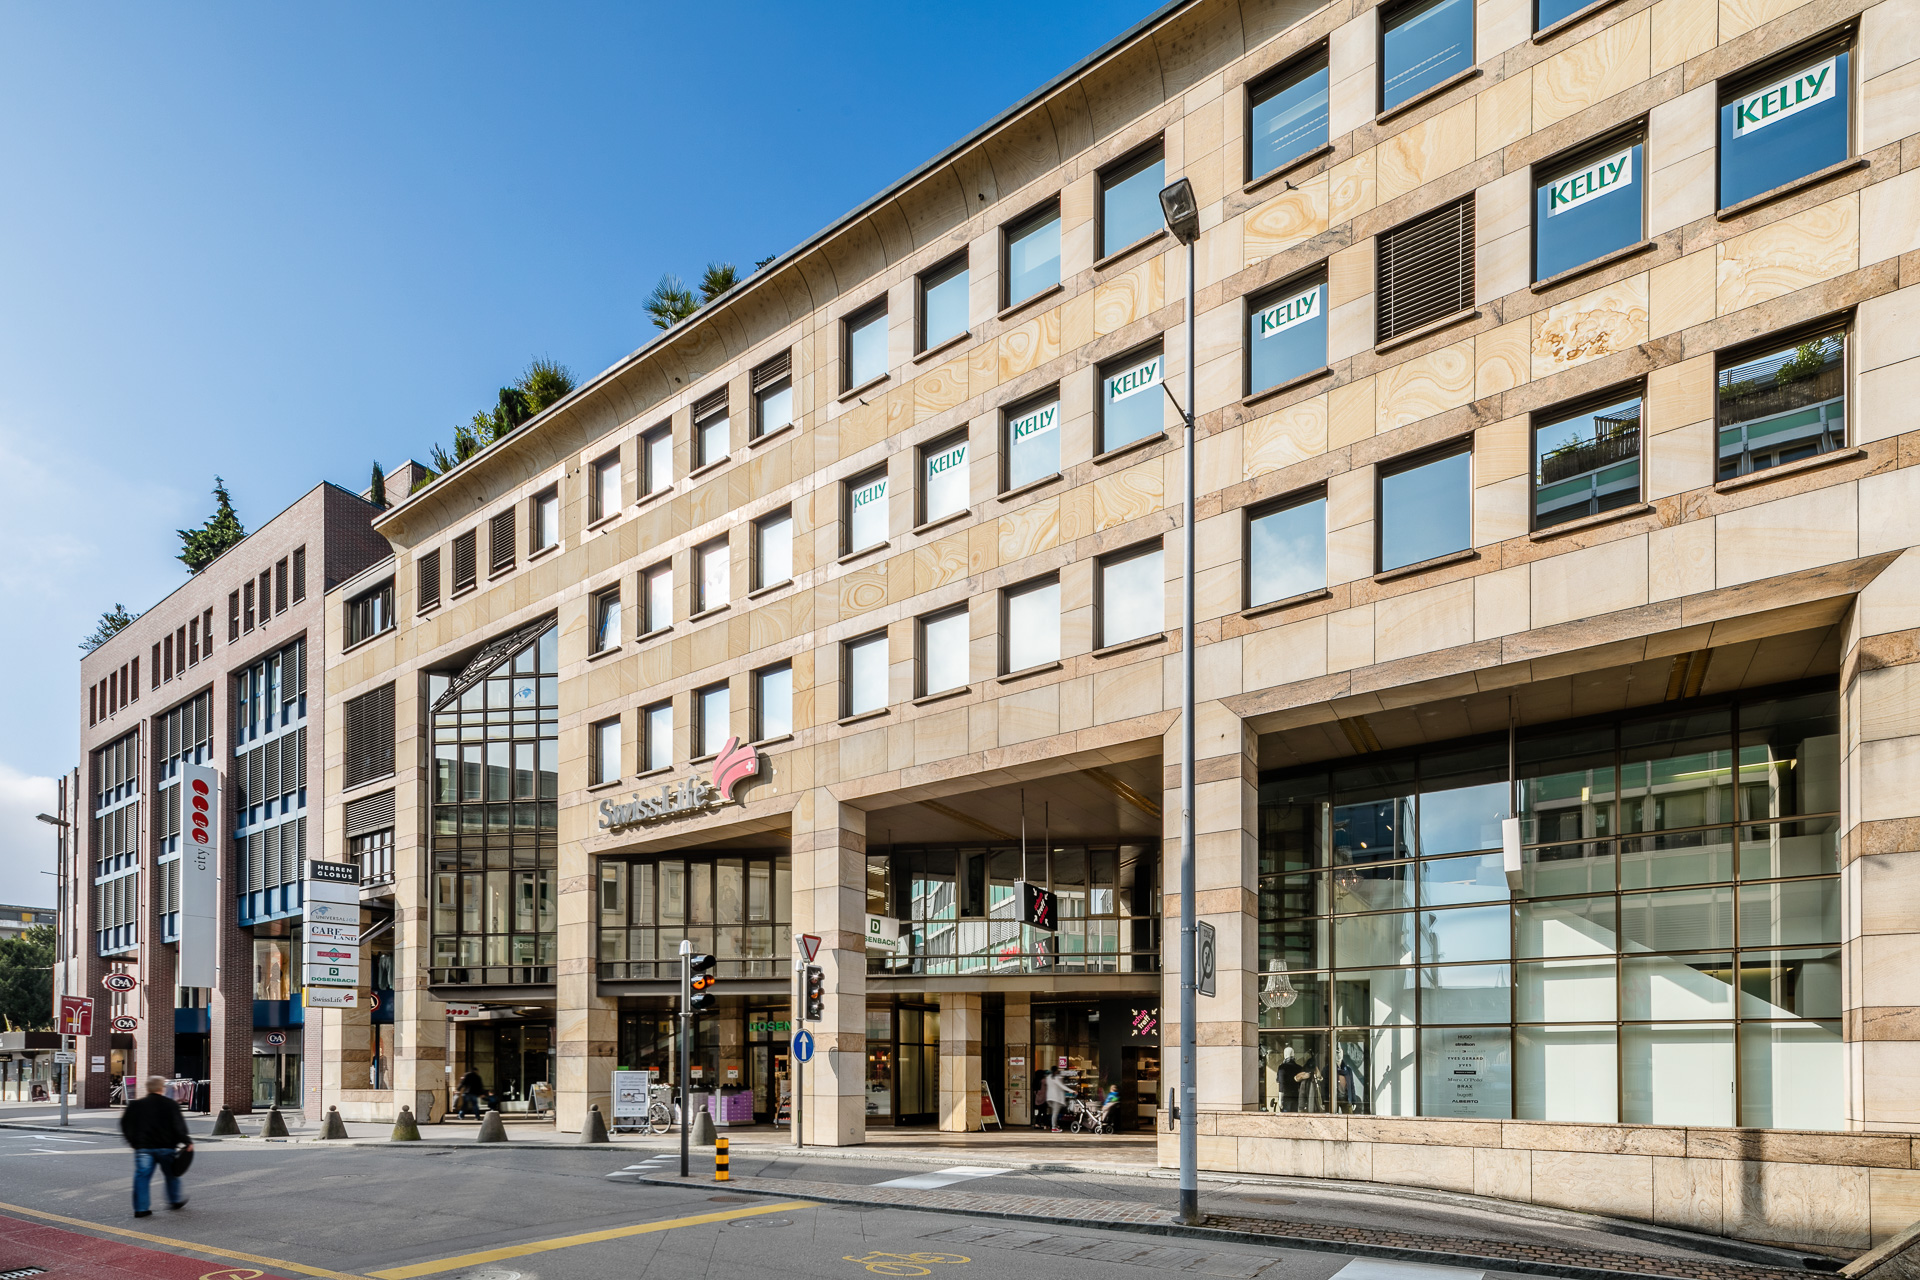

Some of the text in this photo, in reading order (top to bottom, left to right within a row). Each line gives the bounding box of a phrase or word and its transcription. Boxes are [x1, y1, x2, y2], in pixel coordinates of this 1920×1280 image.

[1737, 66, 1830, 130] KELLY
[1550, 155, 1627, 210] KELLY
[1260, 291, 1317, 335] KELLY
[1110, 363, 1157, 399] KELLY
[1014, 407, 1055, 440] KELLY
[929, 447, 966, 476] KELLY
[854, 481, 887, 509] KELLY
[599, 774, 709, 829] SwissLife
[194, 848, 210, 871] city
[317, 865, 353, 873] HERREN
[317, 871, 353, 880] GLOBUS
[311, 926, 343, 936] CARE
[111, 978, 131, 988] C&A
[117, 1019, 135, 1028] C&A
[1132, 1009, 1148, 1026] schuh
[1141, 1018, 1157, 1036] aarau
